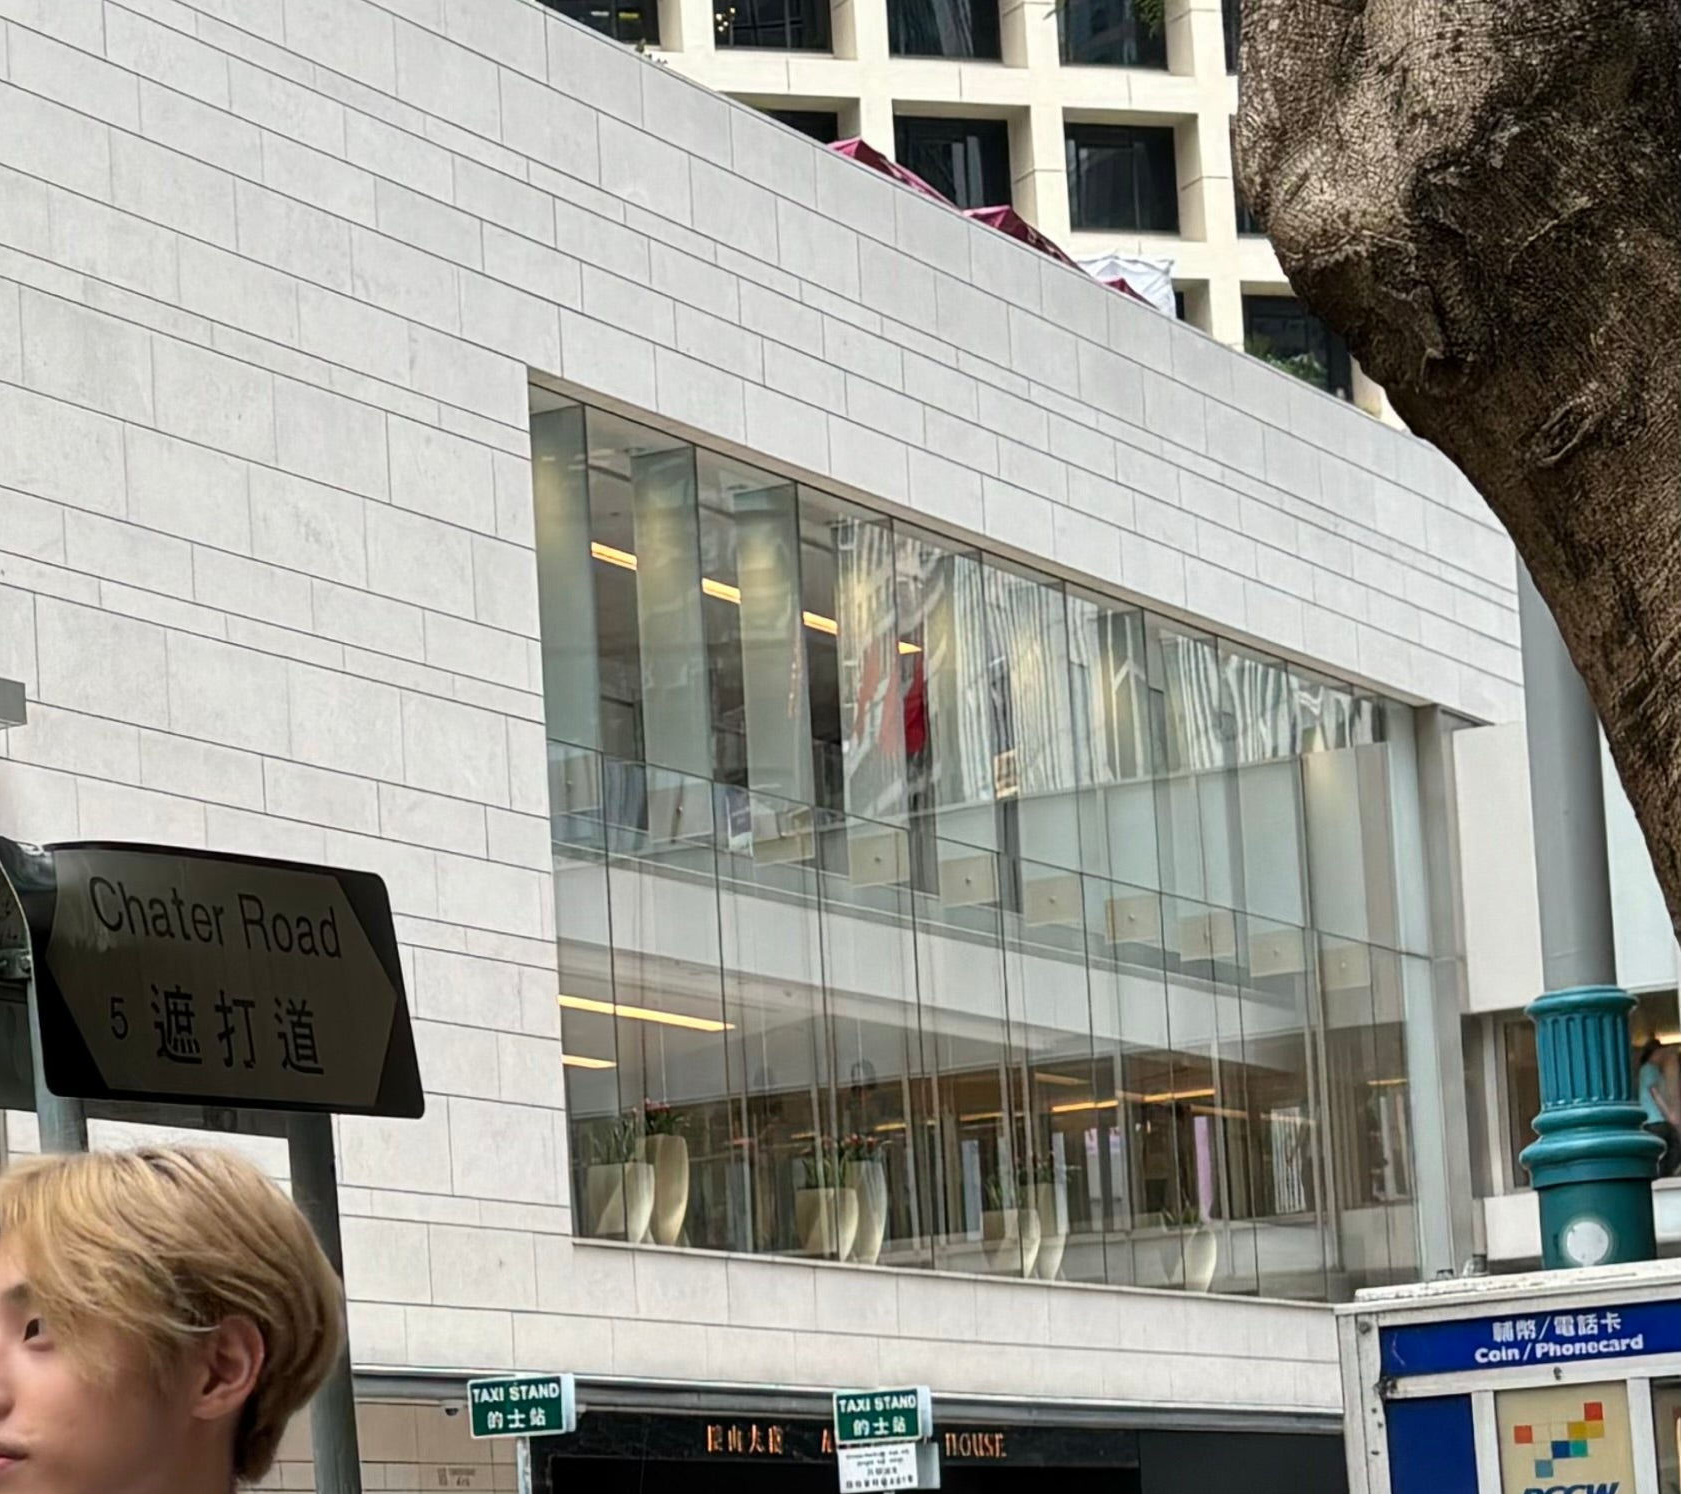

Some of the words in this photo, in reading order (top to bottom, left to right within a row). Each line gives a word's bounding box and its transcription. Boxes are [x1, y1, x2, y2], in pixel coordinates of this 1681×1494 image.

[89, 876, 224, 946] Chater
[238, 893, 341, 958] Road
[110, 997, 129, 1040] 5
[151, 984, 324, 1075] 遮打道
[472, 1387, 505, 1403] TAXI
[509, 1382, 560, 1401] STAND
[839, 1398, 870, 1413] TAXI
[874, 1394, 917, 1411] STAND
[487, 1406, 546, 1430] 的士站
[945, 1432, 1008, 1457] HOUSE
